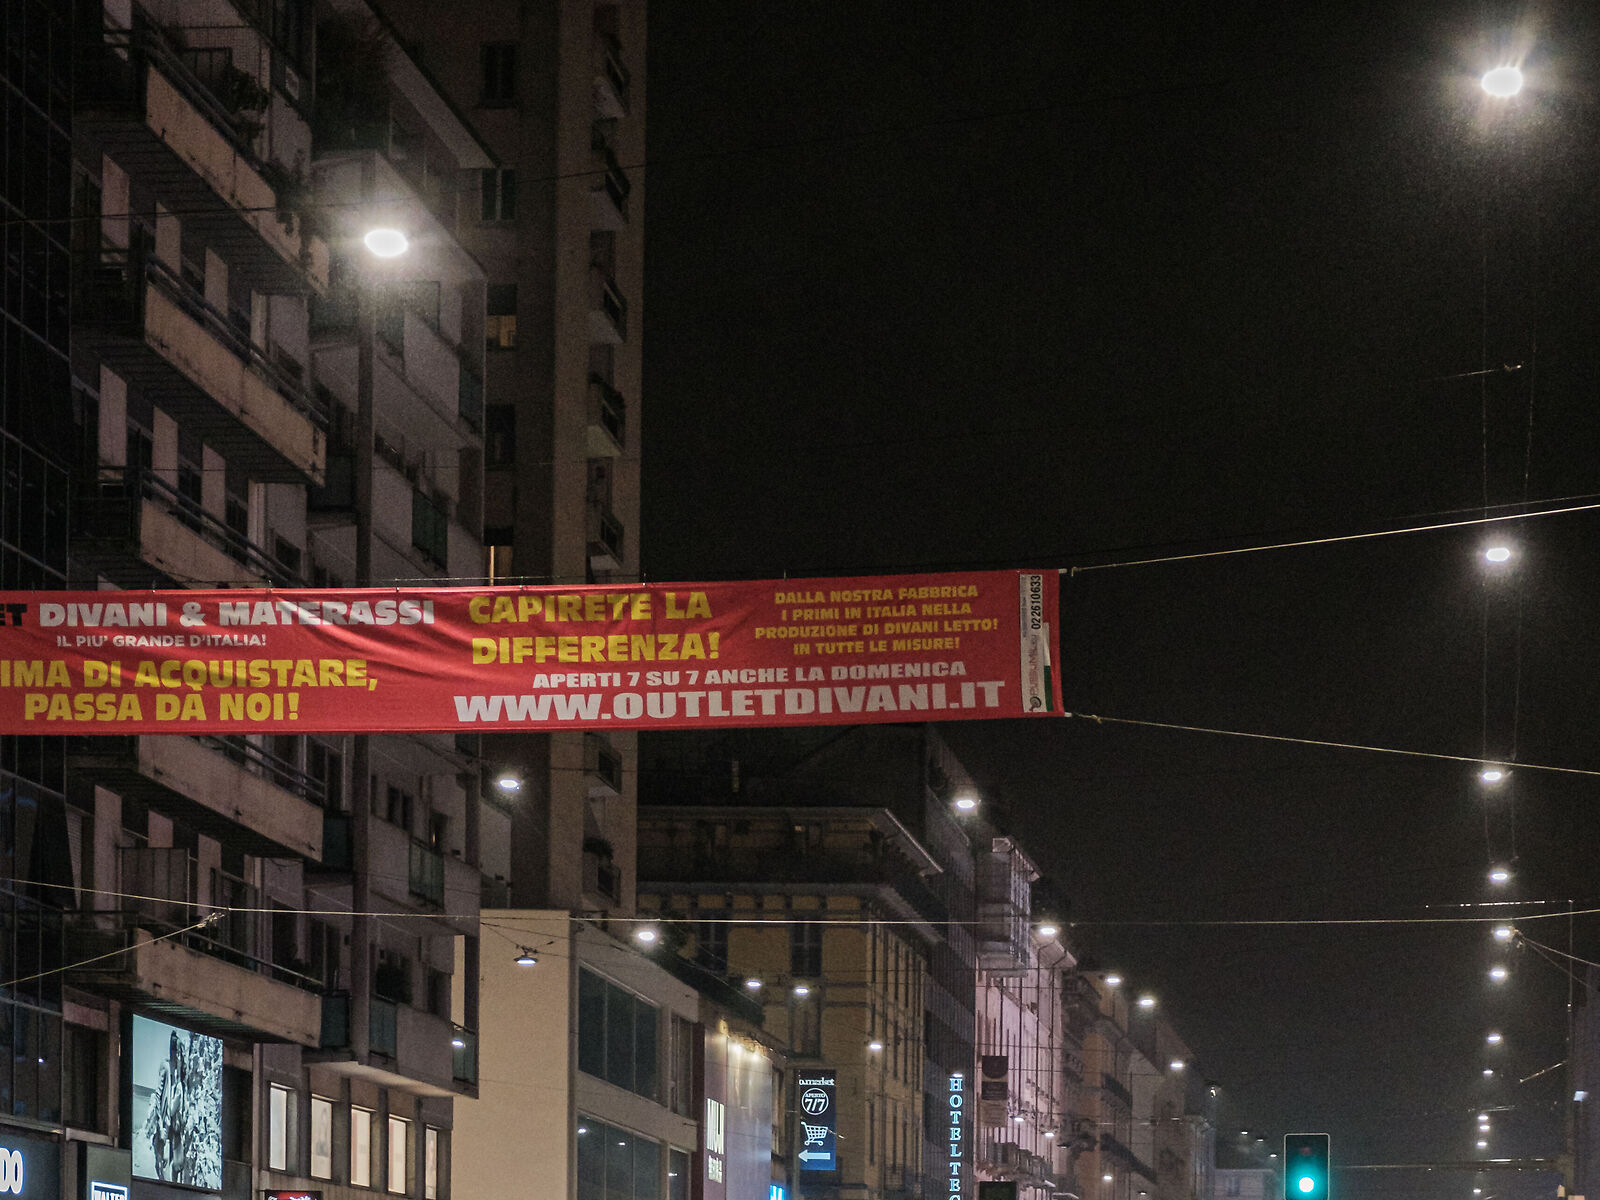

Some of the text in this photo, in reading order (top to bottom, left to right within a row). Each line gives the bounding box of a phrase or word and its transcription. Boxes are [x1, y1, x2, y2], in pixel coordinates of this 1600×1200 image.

[469, 592, 712, 624] CAPIRETE LA
[775, 585, 978, 604] DALLA NOSTRA FABBRICA
[40, 603, 167, 627] DIVANI
[180, 602, 206, 627] &
[219, 600, 435, 626] MATERASSI
[781, 603, 971, 621] I PRIMI IN ITALIA NELLA
[57, 634, 266, 647] IL PIU' GRANDE D'ITALIA!
[755, 618, 998, 639] PRODUZIONE DI DIVANI LETTO!
[472, 632, 720, 665] DIFFERENZA!
[794, 637, 960, 655] IN TUTTE LE MISURE!
[1, 659, 378, 691] IMA DI ACQUISTARE,
[533, 661, 966, 688] APERTI 7 SU 7 ANCHE LA DOMENICA
[25, 692, 299, 721] PASSA DA NOI!
[453, 681, 1005, 722] WWW.OUTLETDIVANI.IT
[804, 1098, 826, 1111] 7/7
[949, 1078, 963, 1157] HOTEL
